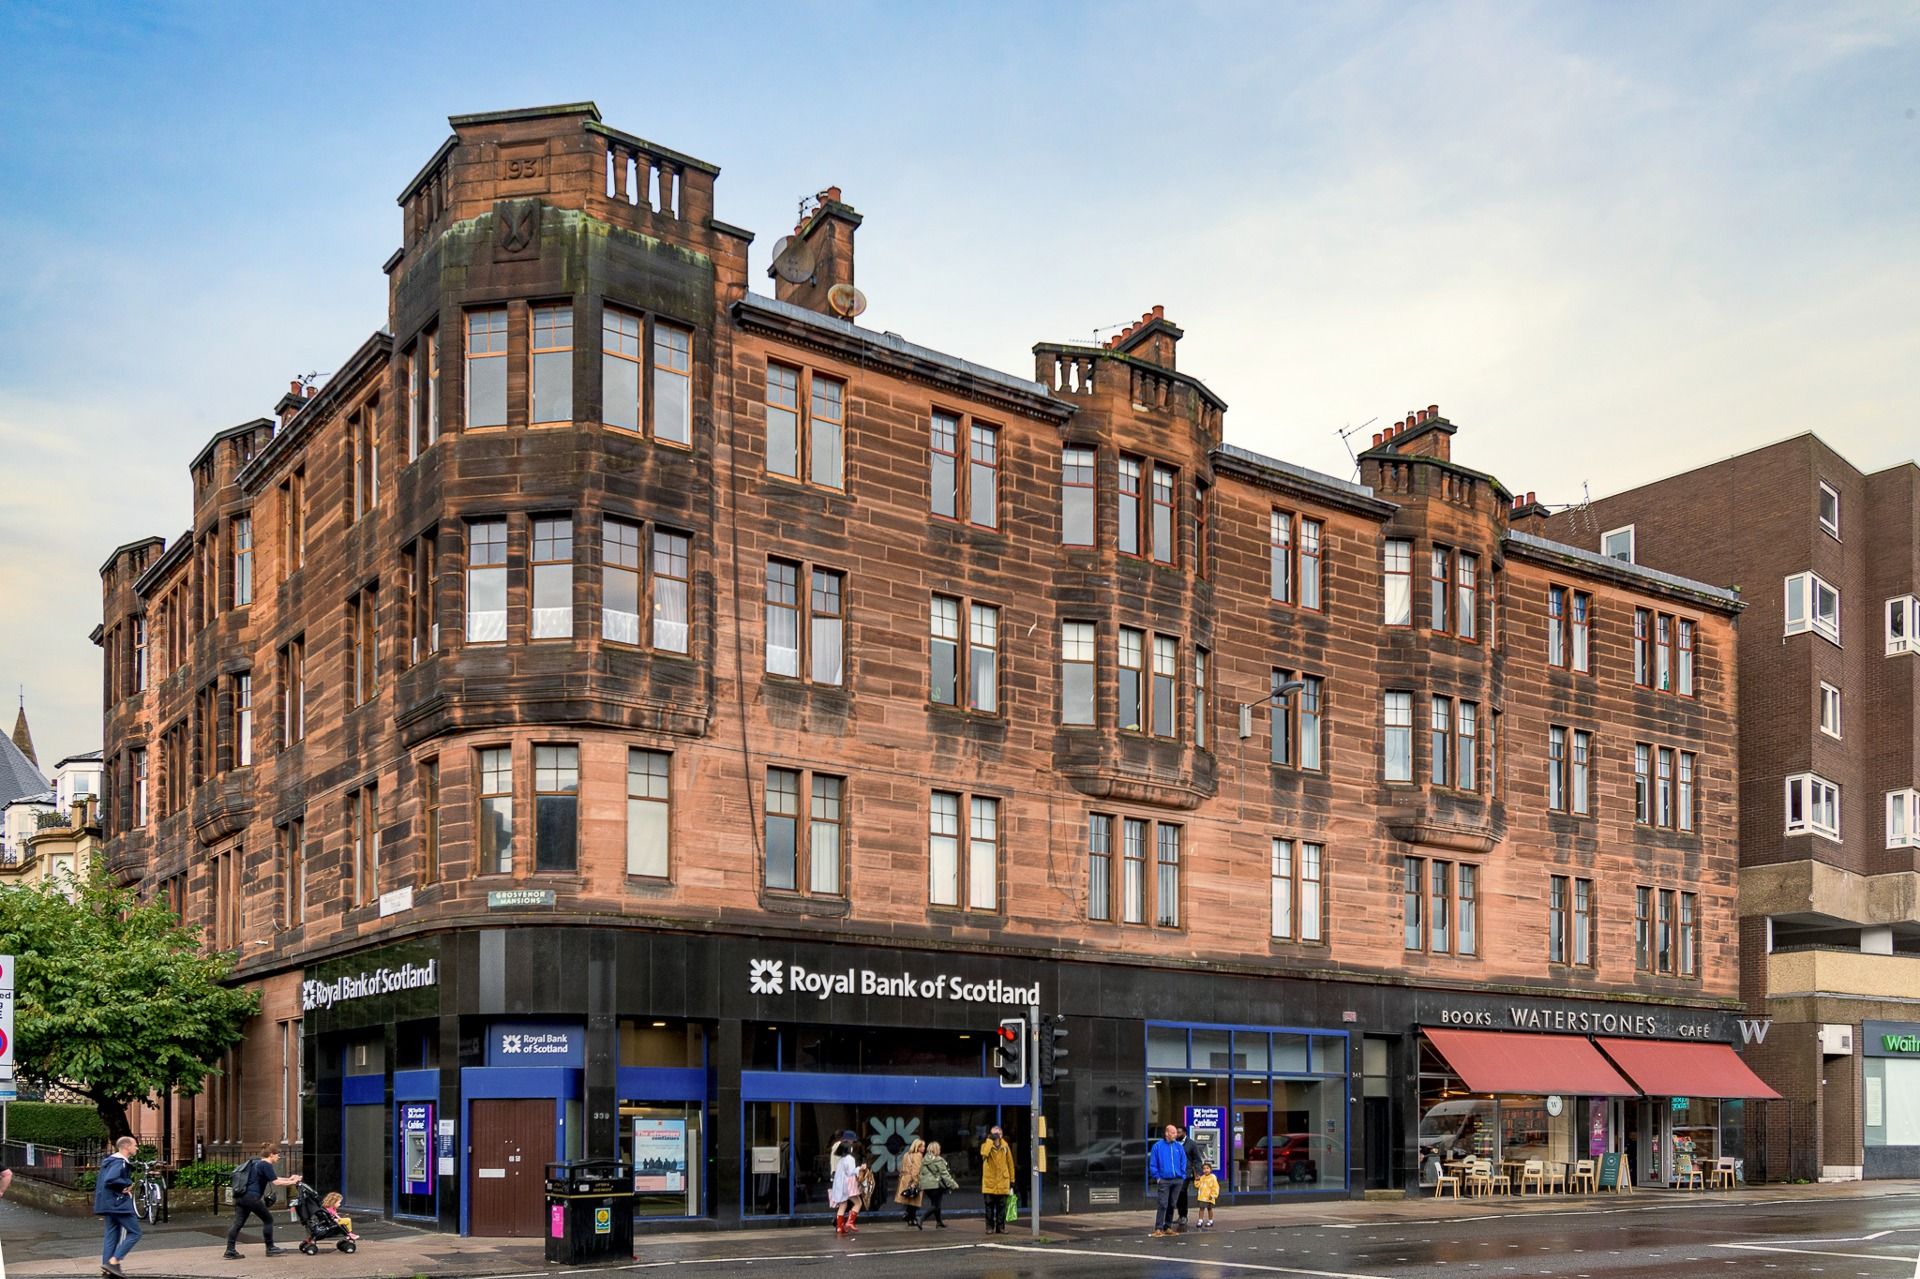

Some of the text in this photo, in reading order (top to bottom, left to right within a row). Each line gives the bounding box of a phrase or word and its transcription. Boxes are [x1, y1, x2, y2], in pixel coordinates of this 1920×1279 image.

[496, 891, 546, 899] GROSVENOR
[316, 959, 436, 1010] Royal Bank of Scotland
[790, 965, 1040, 1006] Royal Bank of Scotland
[1441, 1007, 1710, 1038] BOOKS WATERSTONES CAFÉ
[1737, 1019, 1773, 1044] W
[523, 1034, 568, 1045] Royal Bank
[523, 1044, 568, 1053] of Scotland
